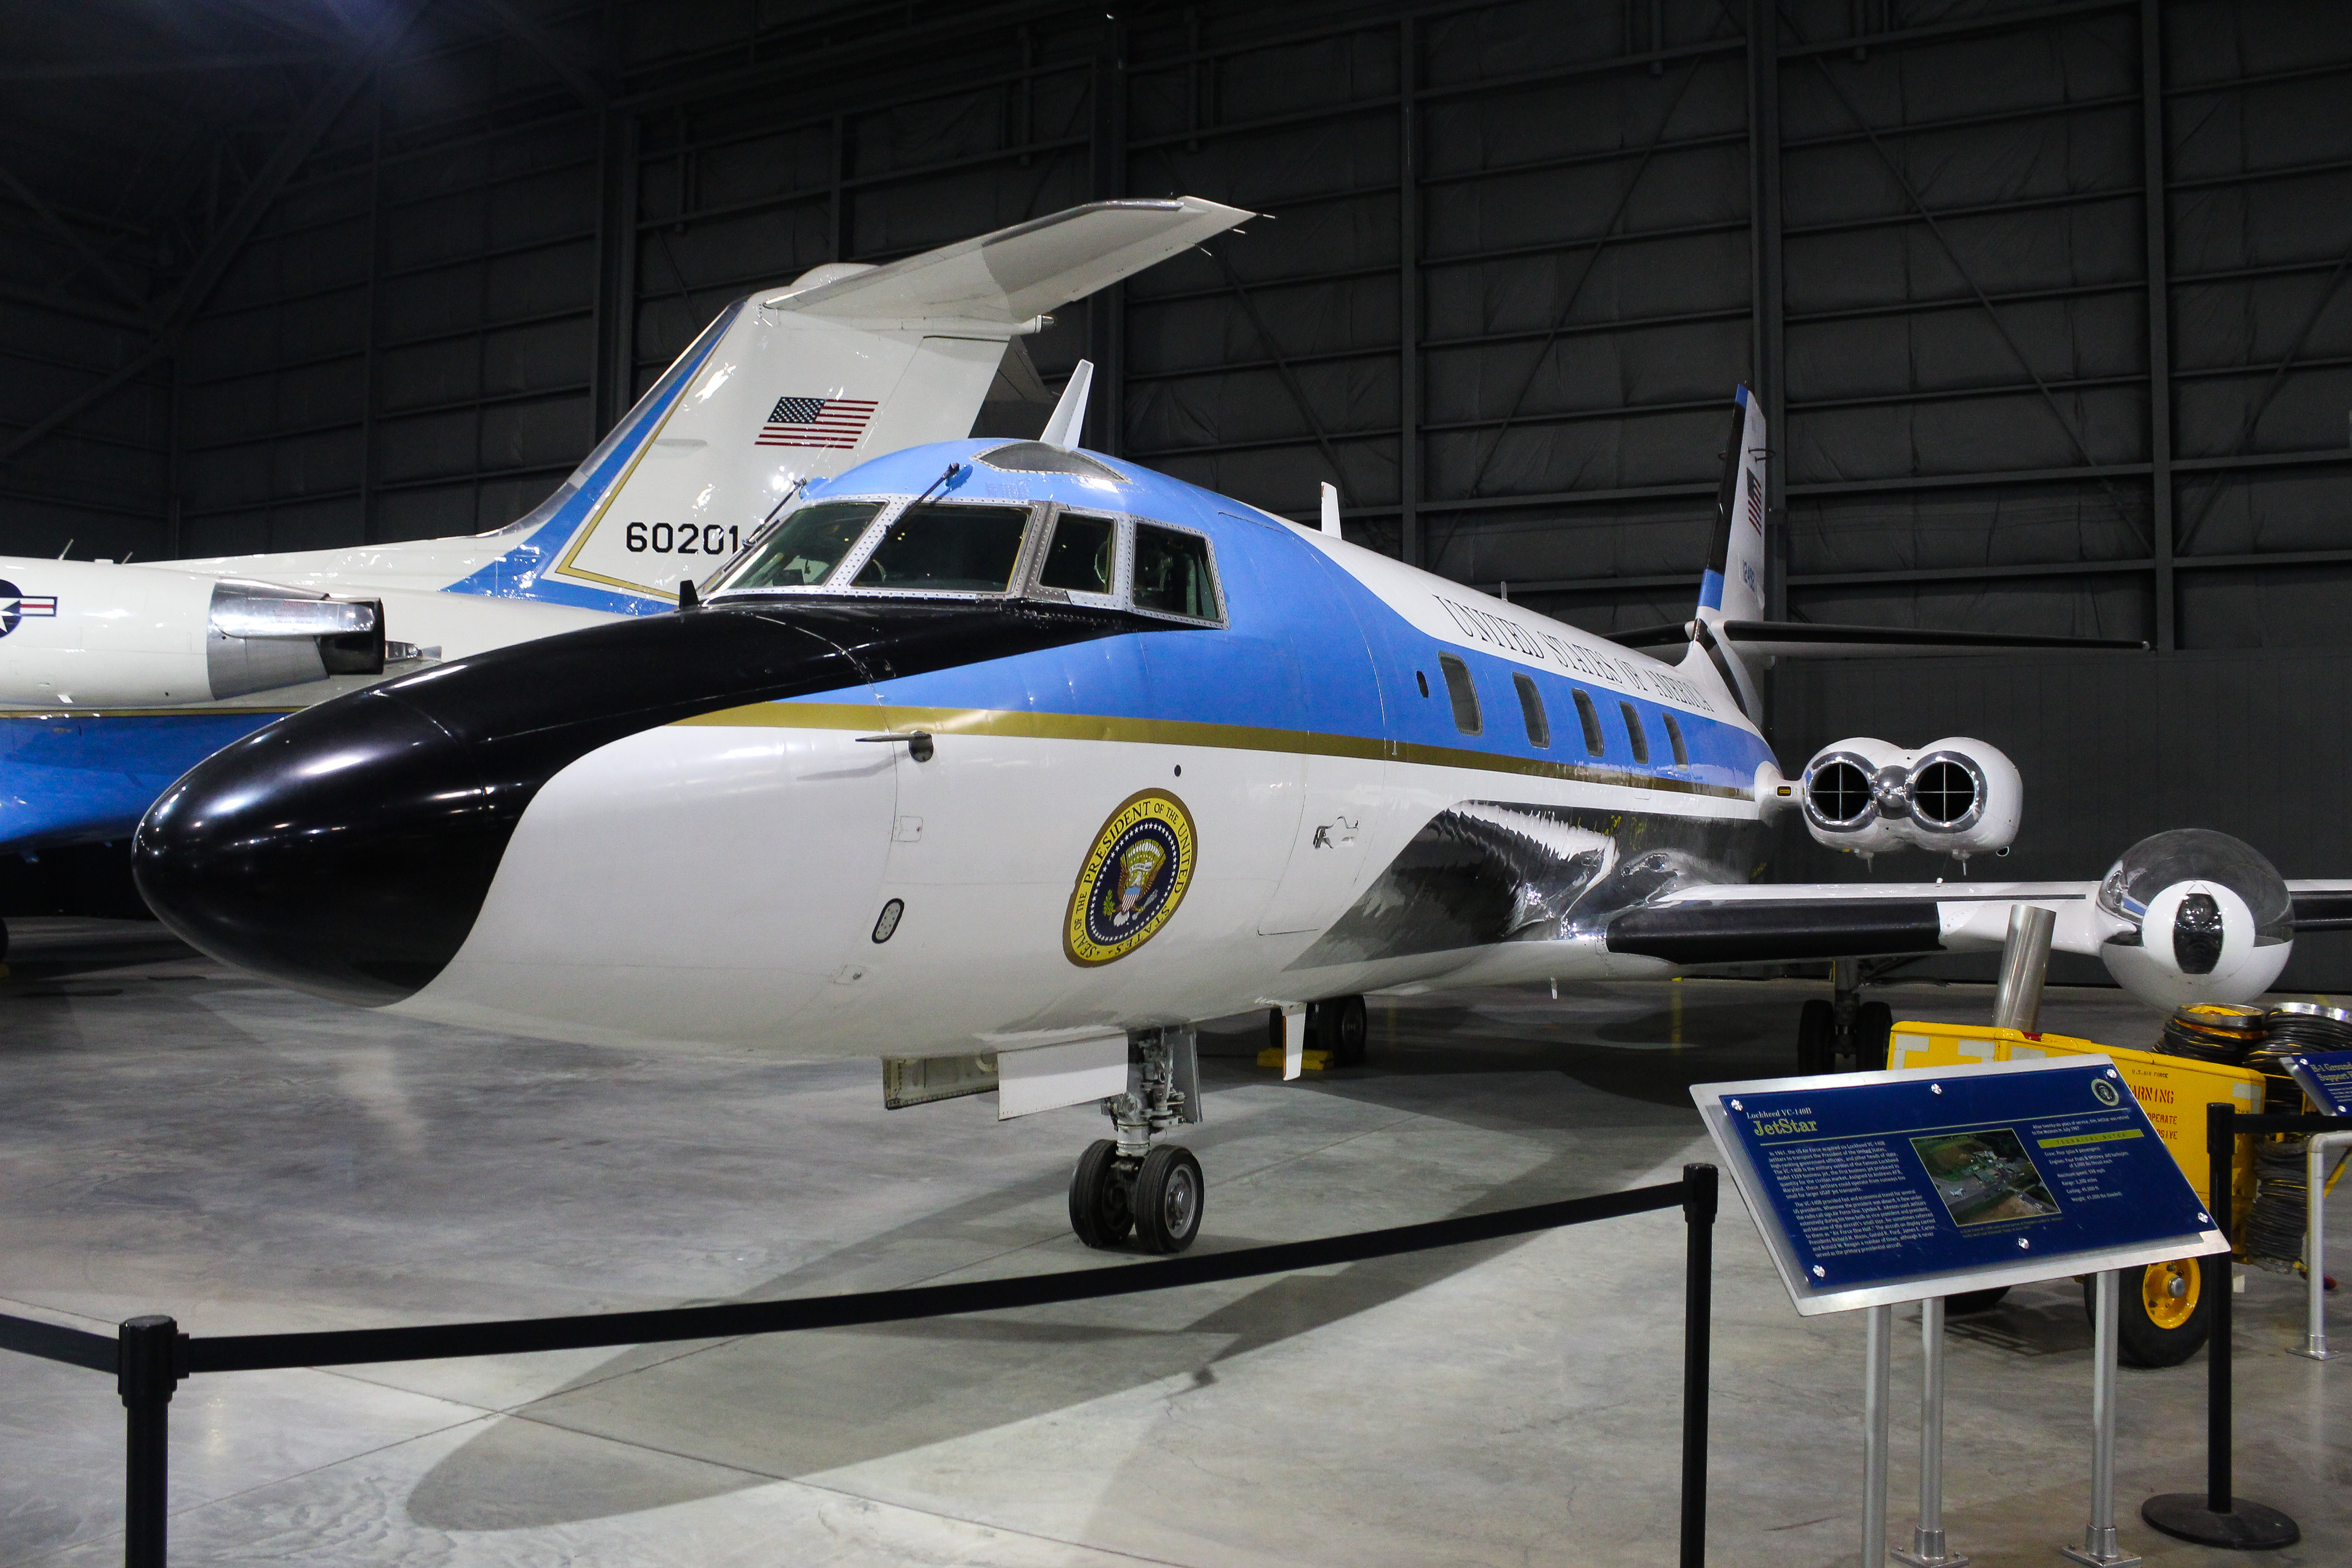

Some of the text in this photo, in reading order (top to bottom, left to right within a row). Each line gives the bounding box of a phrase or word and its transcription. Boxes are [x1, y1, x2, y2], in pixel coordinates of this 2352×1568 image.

[627, 522, 738, 554] 60201
[1432, 594, 1715, 712] UNITED STATES OF AMERICA
[1154, 803, 1164, 814] OF
[1166, 808, 1179, 824] THE
[1085, 801, 1151, 884] PRESIDENT
[1174, 823, 1191, 894] UNITED
[1076, 891, 1087, 914] THE
[1074, 918, 1082, 932] OF
[1114, 906, 1171, 956] STATES
[1073, 934, 1097, 958] SEAL
[2317, 1073, 2349, 1082] Support
[2129, 1085, 2174, 1104] ARNING
[1746, 1107, 1812, 1119] Lockheed VC-140B
[1753, 1118, 1818, 1136] JetStar
